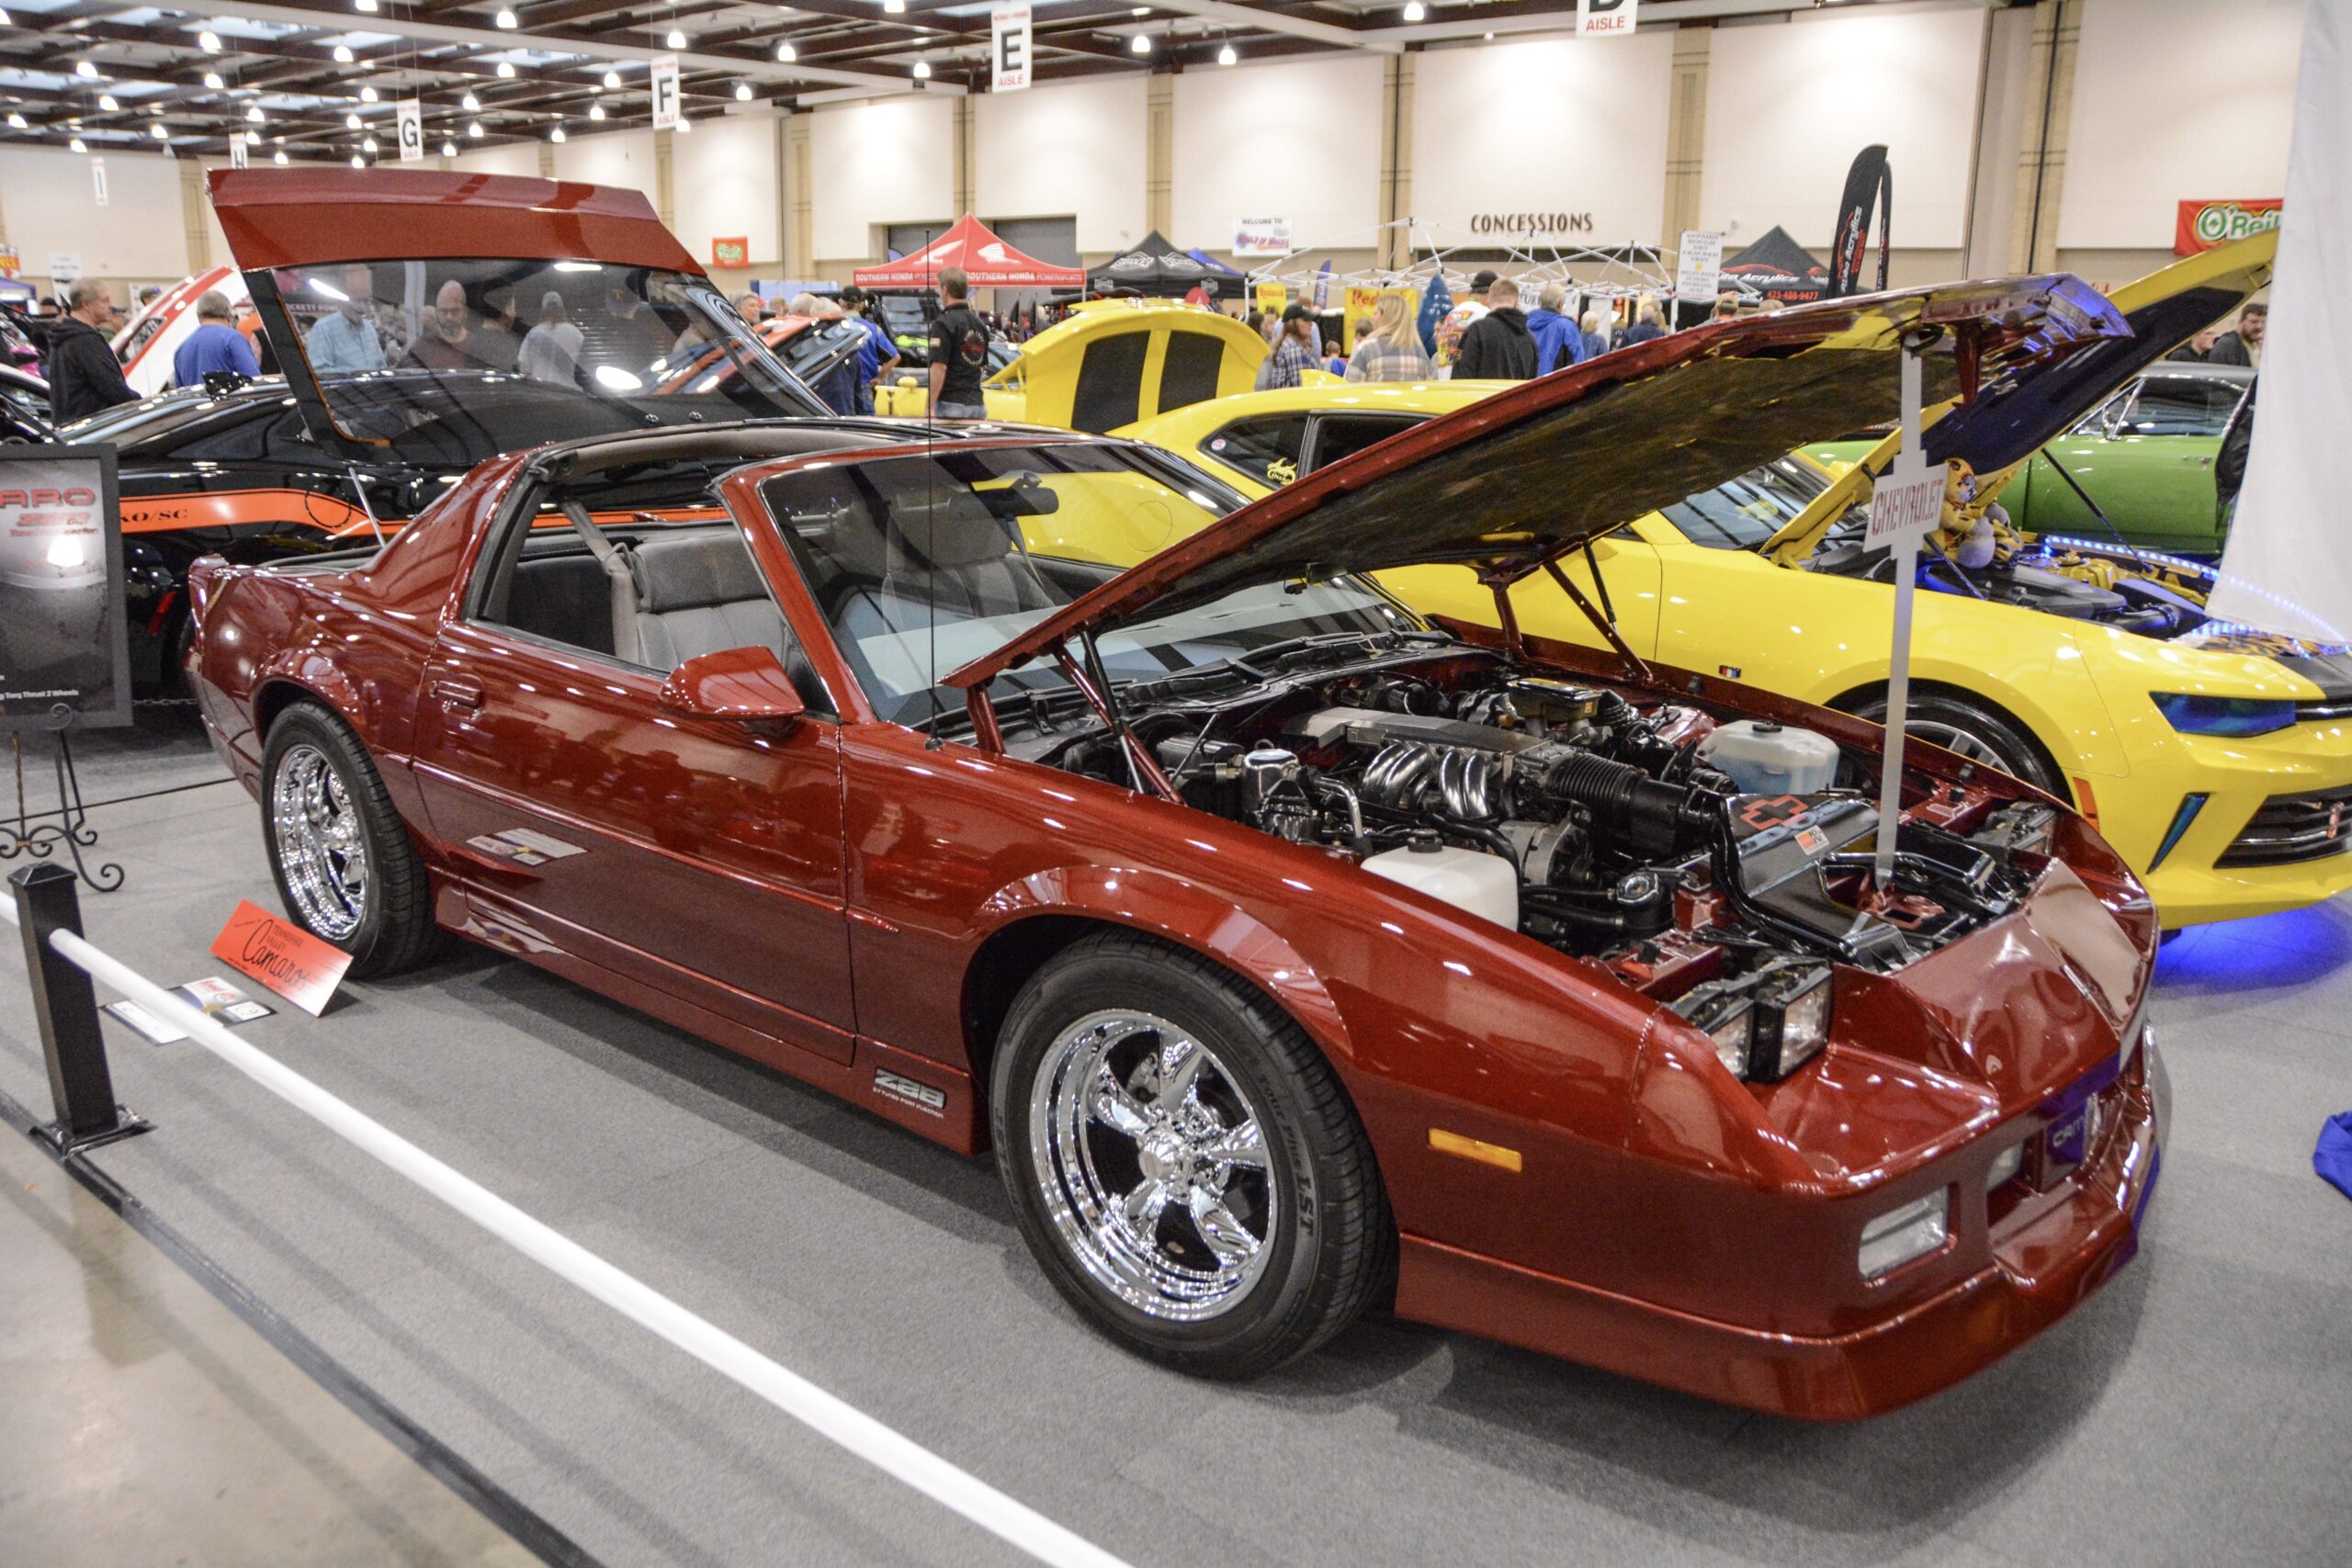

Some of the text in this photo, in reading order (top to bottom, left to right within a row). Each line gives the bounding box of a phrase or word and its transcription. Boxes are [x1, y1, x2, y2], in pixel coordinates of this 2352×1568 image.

[1586, 15, 1625, 31] AISLE
[1001, 27, 1023, 72] E
[999, 74, 1024, 86] AISLE
[658, 76, 673, 112] F
[402, 117, 418, 147] G
[1471, 212, 1593, 232] CONCESSIONS
[855, 273, 889, 281] SOUTHERN
[890, 273, 913, 281] HONDA
[1009, 272, 1035, 280] HONDA
[1739, 273, 1801, 285] Acrylics
[1871, 479, 1943, 536] CHEVROLET
[52, 688, 80, 697] Wheels
[874, 1067, 946, 1110] Z28
